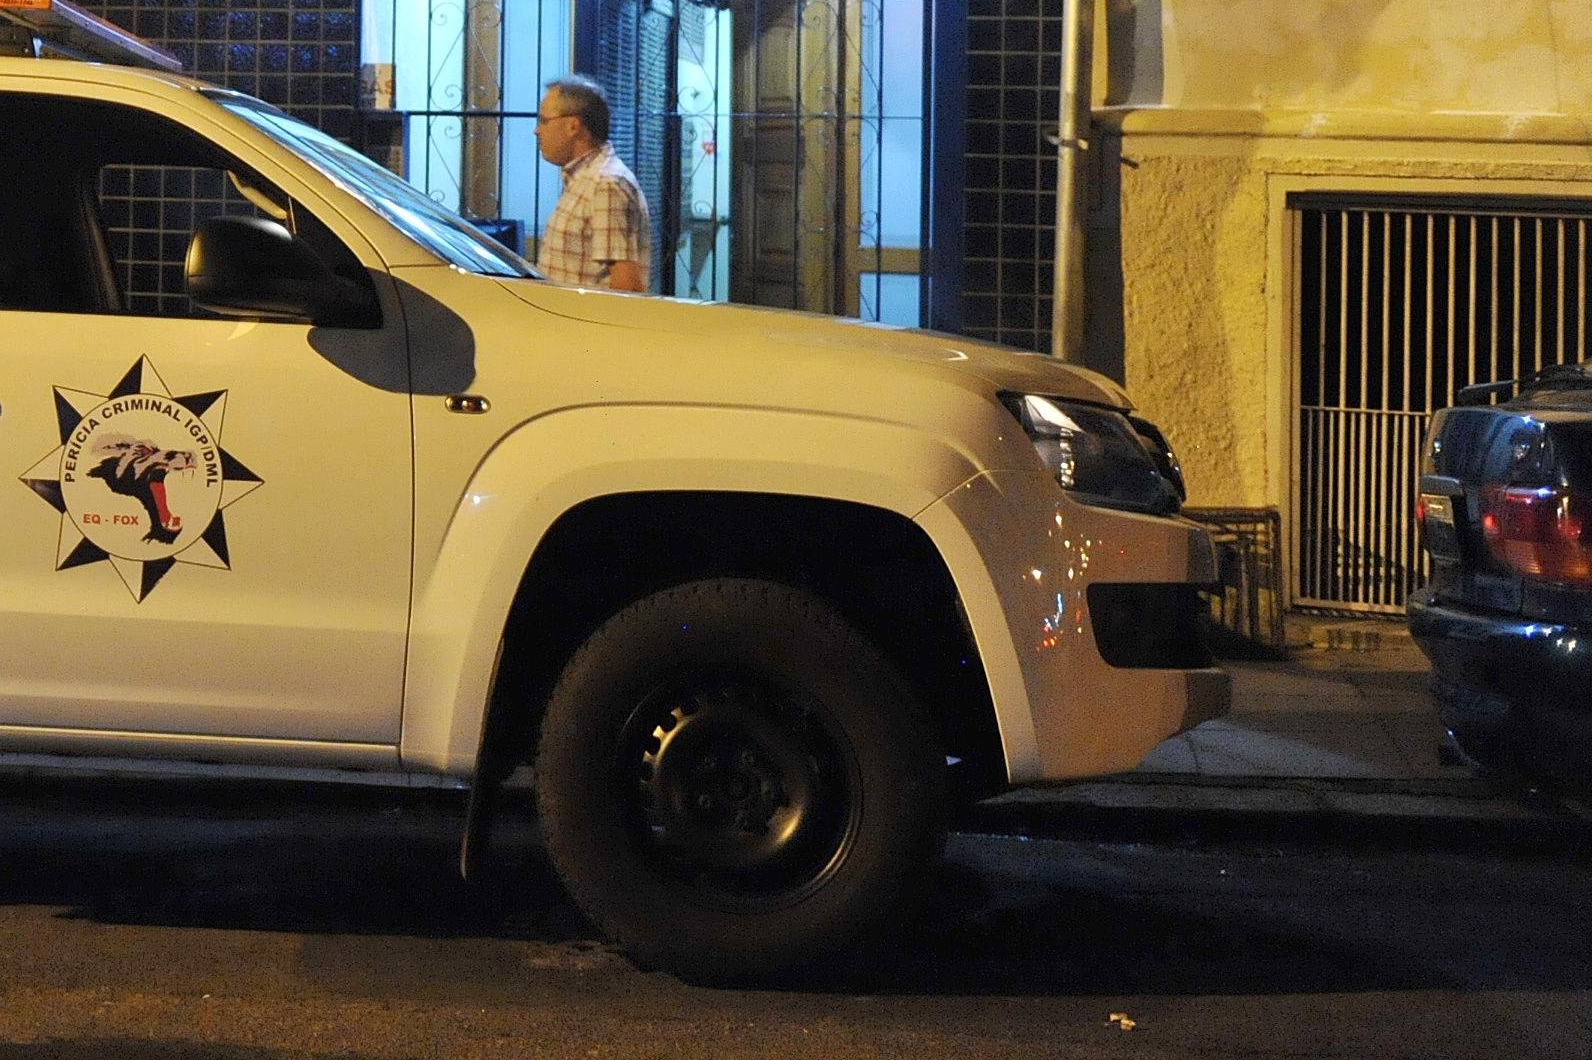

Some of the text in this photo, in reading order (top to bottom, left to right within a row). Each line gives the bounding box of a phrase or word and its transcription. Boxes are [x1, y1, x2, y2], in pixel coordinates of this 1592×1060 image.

[64, 418, 100, 482] PERÍCIA
[101, 398, 181, 422] CRIMINAL
[83, 513, 101, 524] EQ
[113, 514, 139, 525] FOX
